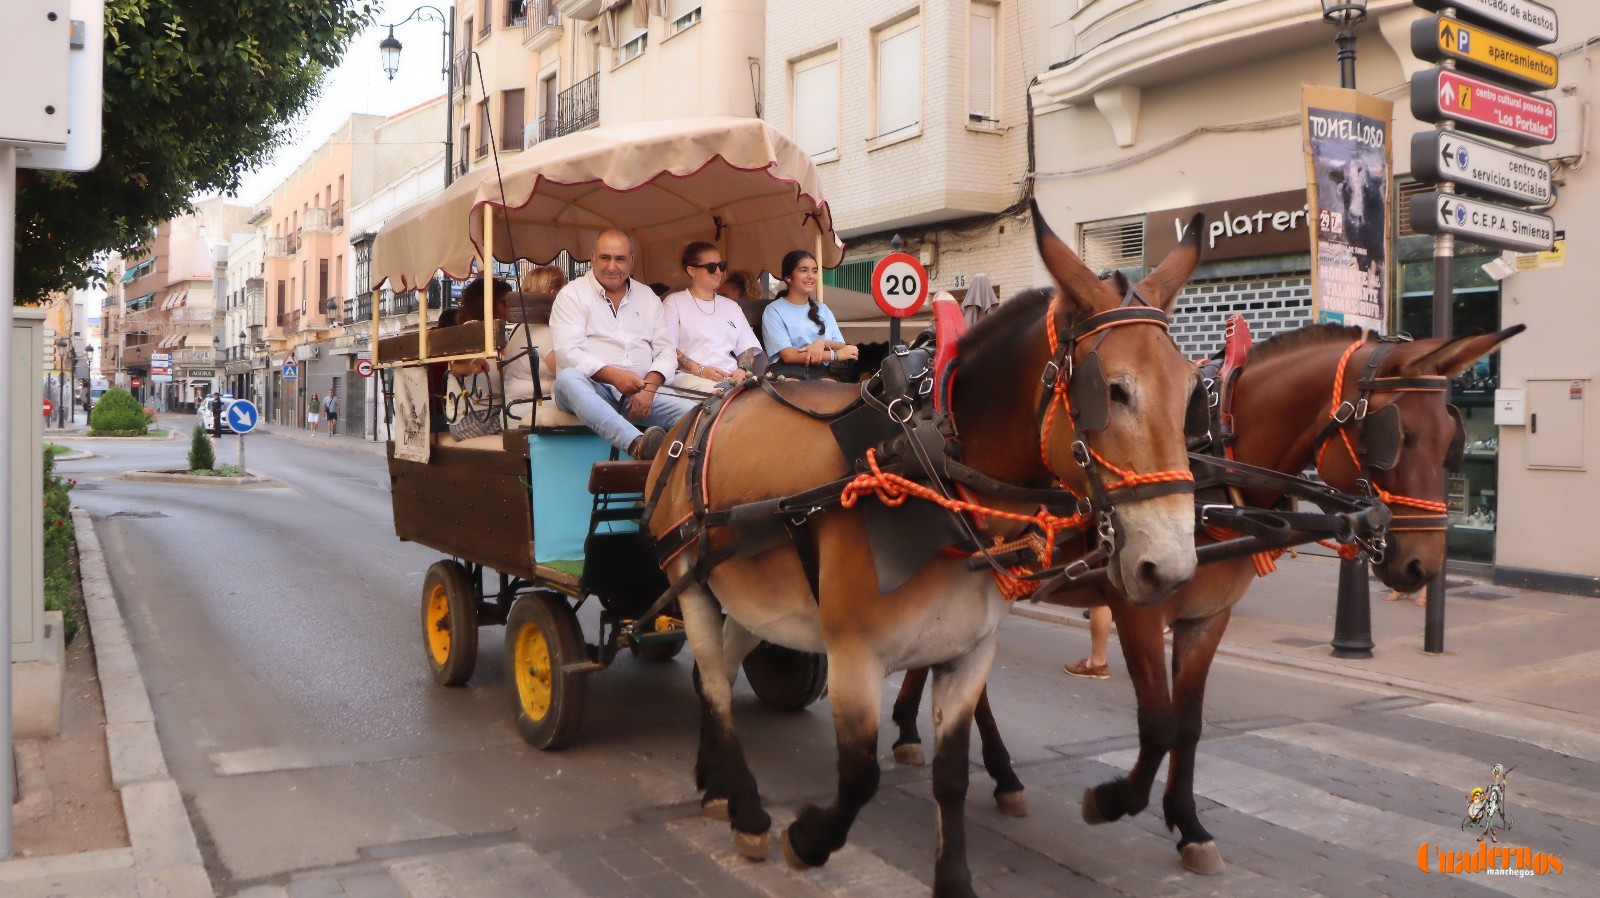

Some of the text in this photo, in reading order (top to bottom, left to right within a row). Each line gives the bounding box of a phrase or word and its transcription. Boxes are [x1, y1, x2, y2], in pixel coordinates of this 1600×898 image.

[1510, 4, 1520, 17] de
[1522, 10, 1554, 31] abastos
[1488, 45, 1553, 76] aparcamientos
[1475, 88, 1497, 101] centro
[1497, 94, 1522, 108] cultural
[1522, 101, 1544, 116] posada
[1544, 107, 1553, 117] de
[1309, 115, 1384, 148] TOMELLOSO
[1472, 168, 1547, 197] servicios sociales
[1509, 161, 1548, 180] centro de
[1209, 203, 1310, 249] plateri
[1472, 211, 1550, 240] C.E.P.A. Simienza
[885, 274, 917, 295] 20
[954, 275, 965, 288] 35
